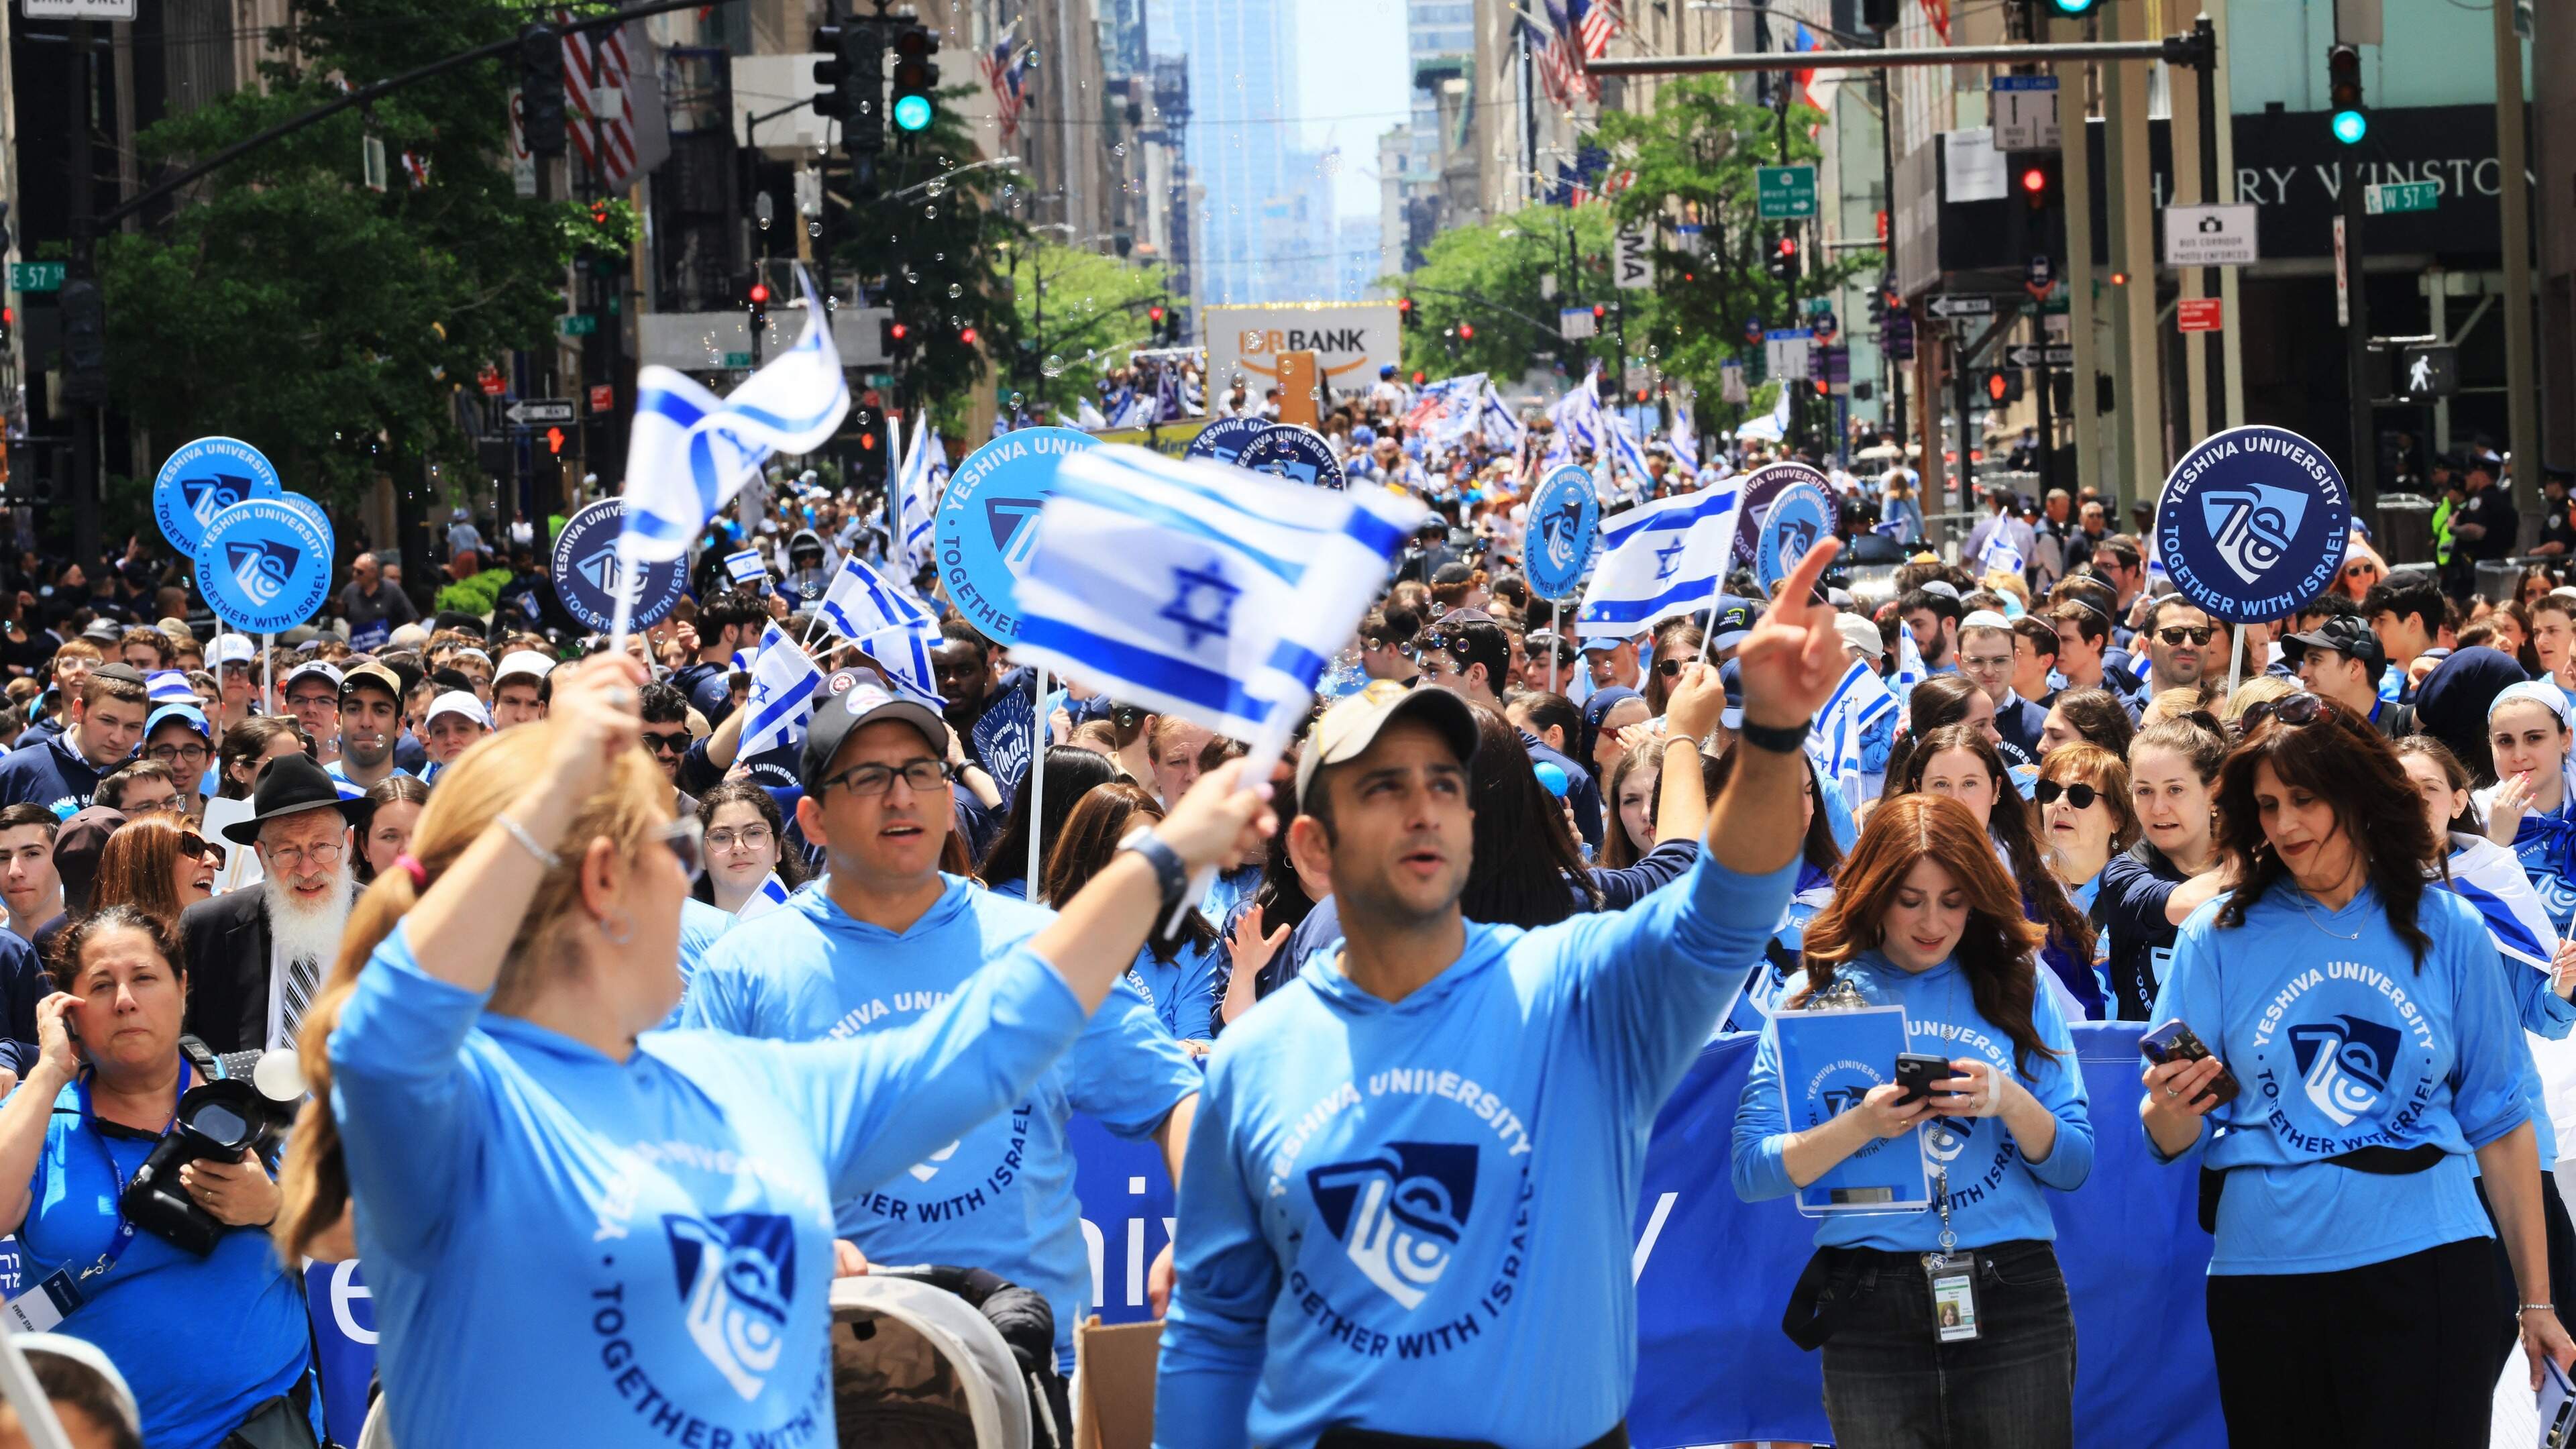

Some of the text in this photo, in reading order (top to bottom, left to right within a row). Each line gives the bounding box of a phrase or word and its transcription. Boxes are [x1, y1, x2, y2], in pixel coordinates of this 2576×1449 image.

[2382, 189, 2397, 209] W
[2404, 187, 2420, 208] 57
[12, 266, 21, 287] E
[29, 266, 47, 288] 57
[1193, 420, 1244, 450] YESHIVA
[1238, 431, 1337, 474] ESHIVA UNIVERSITY
[159, 443, 275, 490] YESHIVA UNIVERSITY
[945, 441, 1028, 511] YESHIVA
[1766, 468, 1831, 496] UNIVERSITY
[2167, 437, 2342, 506] YESHIVA UNIVERSITY
[1528, 472, 1596, 532] YESHIVA UNIVERSITY
[1766, 490, 1829, 535] YESHIVA UNIVERSITY
[201, 507, 325, 559] YESHIVA UNIVERSITY
[556, 524, 587, 583] YESHIVA
[1527, 546, 1555, 593] TOGETHER
[1557, 570, 1578, 592] WITH
[2164, 525, 2344, 616] TOGETHER WITH ISRAEL
[199, 562, 327, 629] TOGETHER WITH ISRAEL
[565, 591, 636, 629] TOGETHR
[639, 594, 674, 625] WITH
[991, 719, 1014, 745] Yisrael
[2253, 961, 2436, 1051] YESHIVA UNIVERSITY
[1907, 1020, 2012, 1076] UNIVERSIT
[1807, 1063, 1837, 1101] YESHIVA
[1269, 1068, 1532, 1197] YESHIVA UNIVERSITY
[1854, 1145, 1879, 1160] WITH
[917, 1187, 985, 1223] WITH
[987, 1103, 1032, 1195] ISRAEL
[1930, 1183, 1985, 1214] WITH
[12, 1304, 27, 1321] EVENT
[1396, 1313, 1481, 1360] WITH
[591, 1282, 734, 1449] TOGETHER
